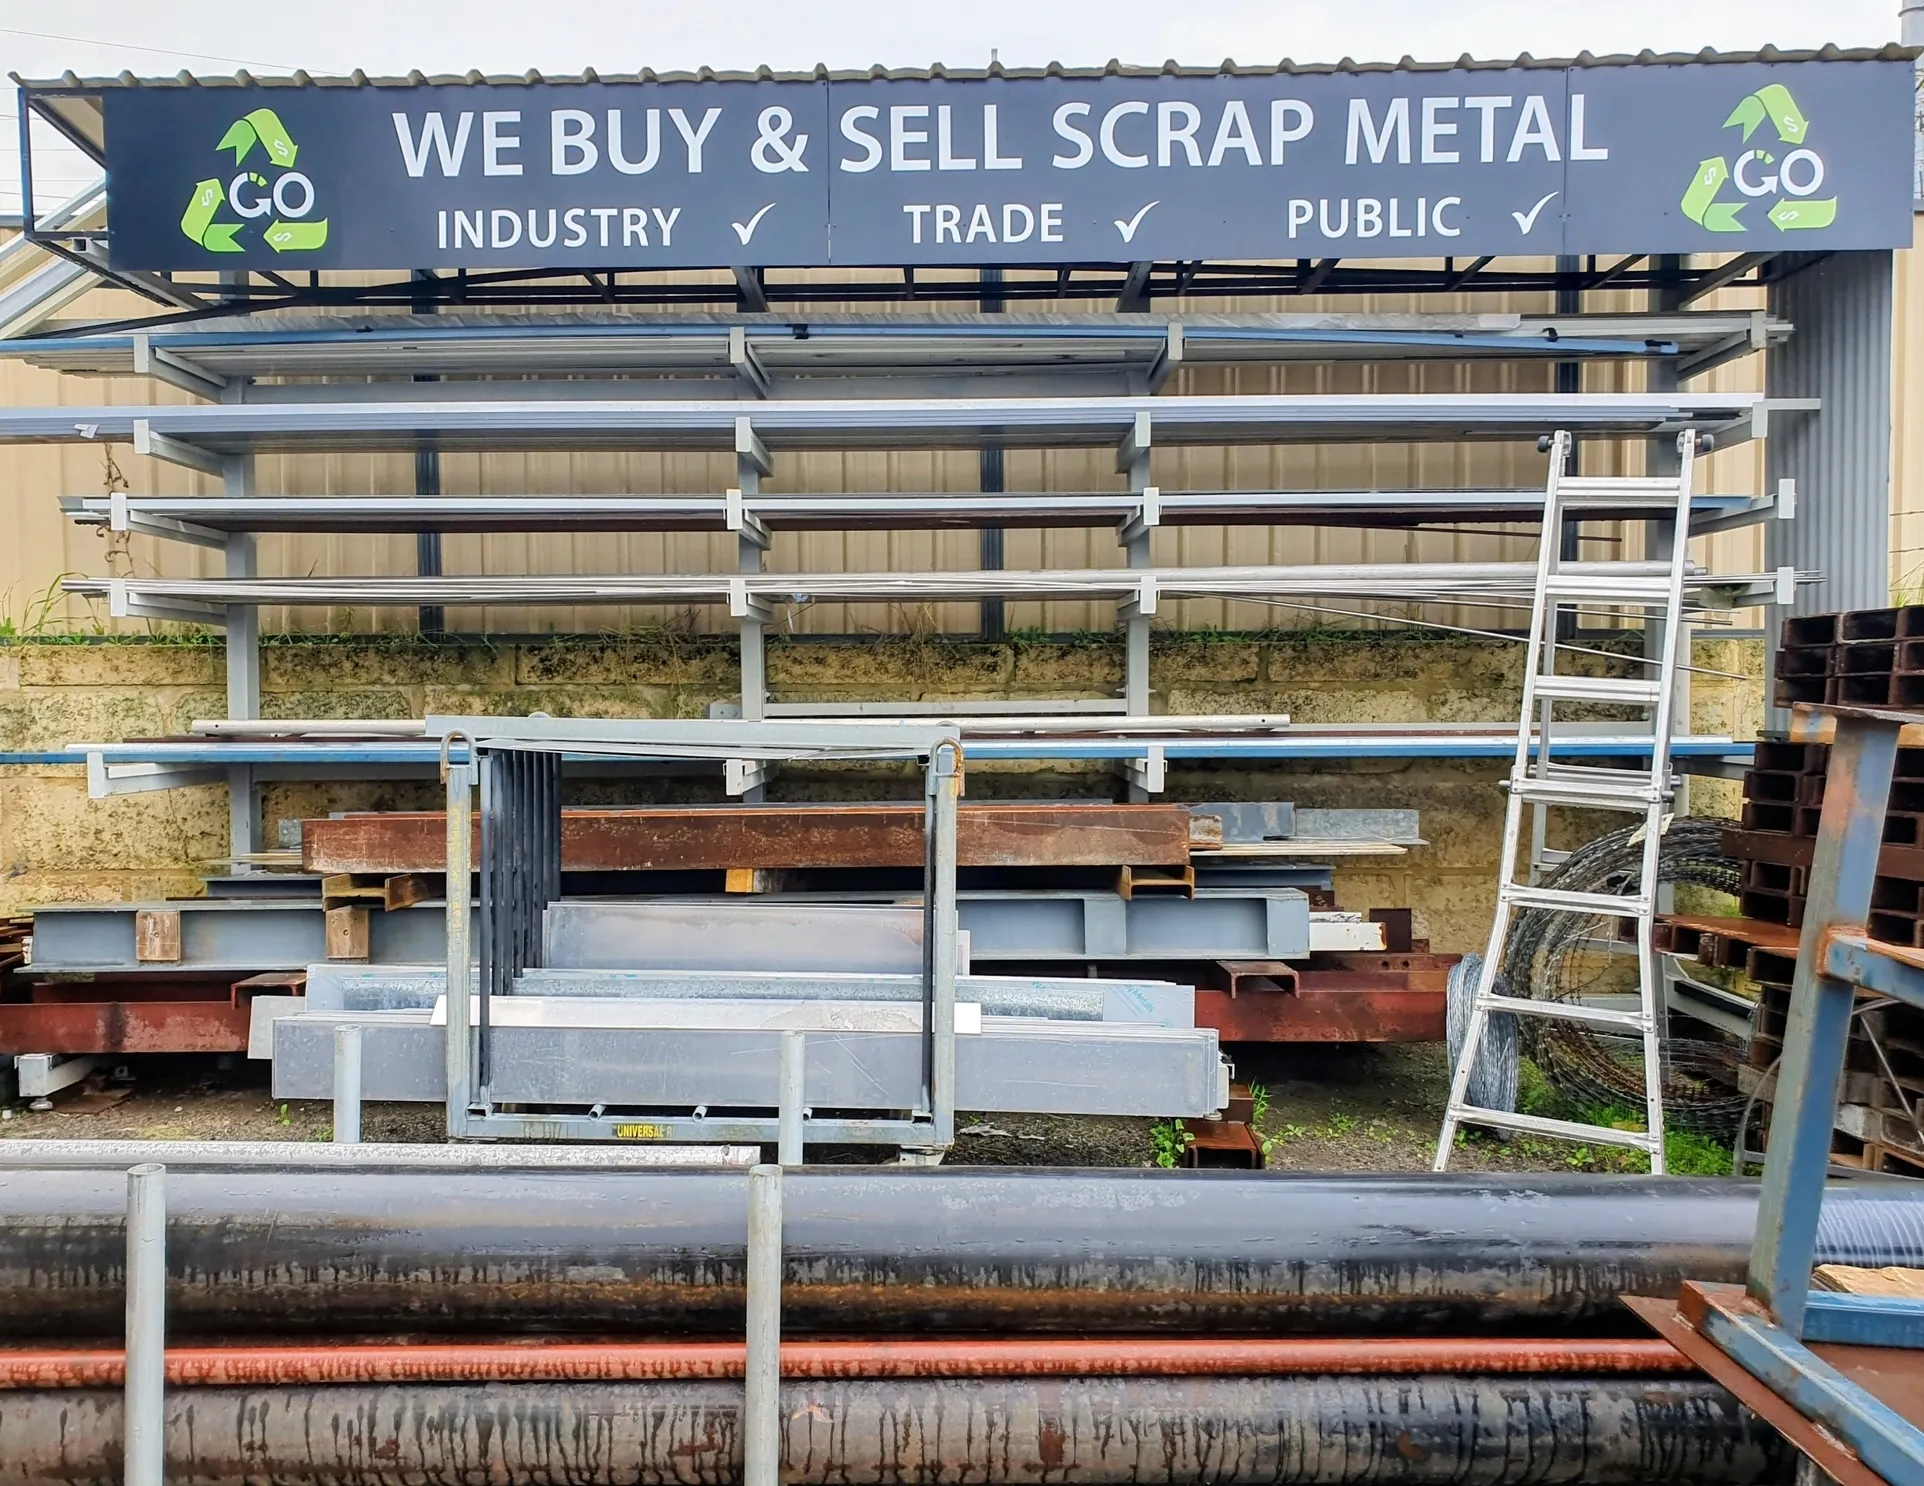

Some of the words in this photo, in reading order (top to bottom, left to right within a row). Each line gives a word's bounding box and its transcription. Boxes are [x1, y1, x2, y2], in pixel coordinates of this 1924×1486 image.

[391, 111, 523, 178] WE
[550, 107, 723, 176] BUY
[749, 106, 810, 174] &
[839, 104, 1023, 174] SELL
[1051, 99, 1315, 170] SCRAP
[1344, 93, 1609, 165] METAL
[1733, 147, 1825, 198] GO
[228, 171, 316, 219] GO
[437, 206, 682, 250] INDUSTRY
[902, 202, 1065, 245] TRADE
[1287, 196, 1462, 239] PUBLIC
[617, 1123, 664, 1138] UNIVERSAL
